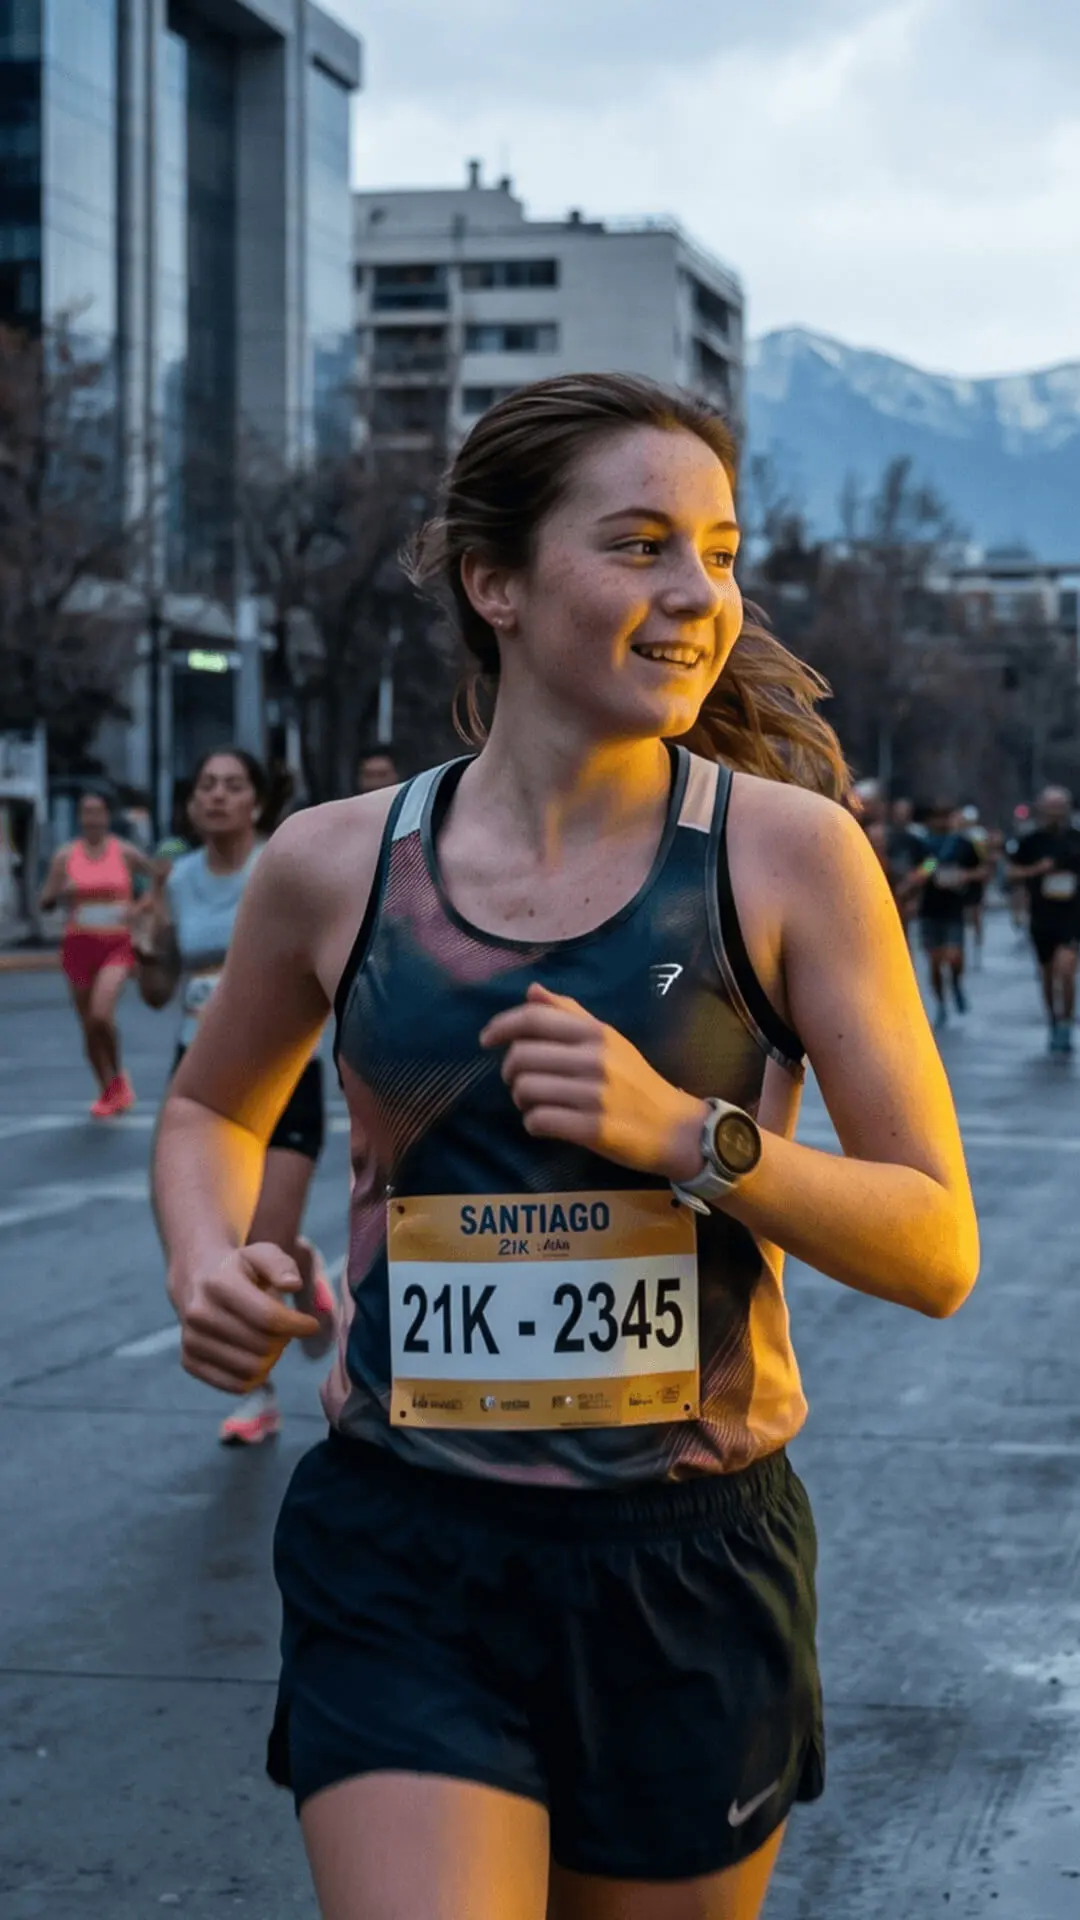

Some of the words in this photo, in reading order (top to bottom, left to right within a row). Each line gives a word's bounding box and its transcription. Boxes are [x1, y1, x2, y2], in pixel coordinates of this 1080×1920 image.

[460, 1202, 610, 1235] SANTIAGO
[498, 1238, 529, 1256] 21K
[402, 1284, 500, 1354] 21K
[518, 1321, 536, 1336] -
[553, 1278, 683, 1353] 2345
